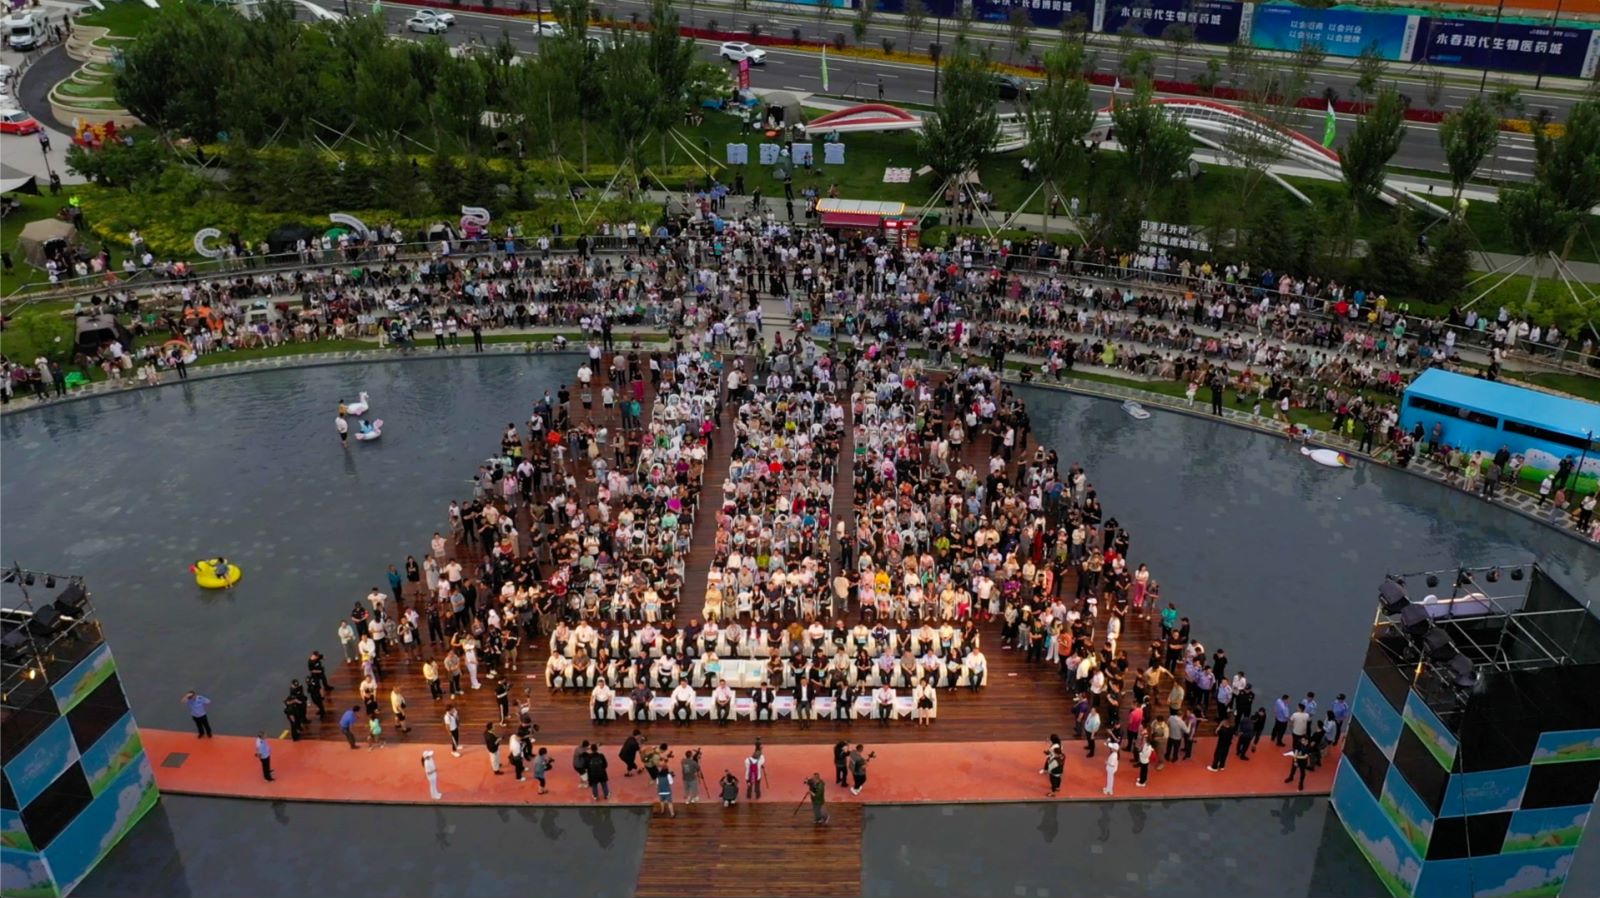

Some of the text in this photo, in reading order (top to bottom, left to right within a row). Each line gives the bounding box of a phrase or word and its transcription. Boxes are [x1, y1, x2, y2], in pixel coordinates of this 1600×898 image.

[1436, 33, 1564, 55] 永春现代生物医药城
